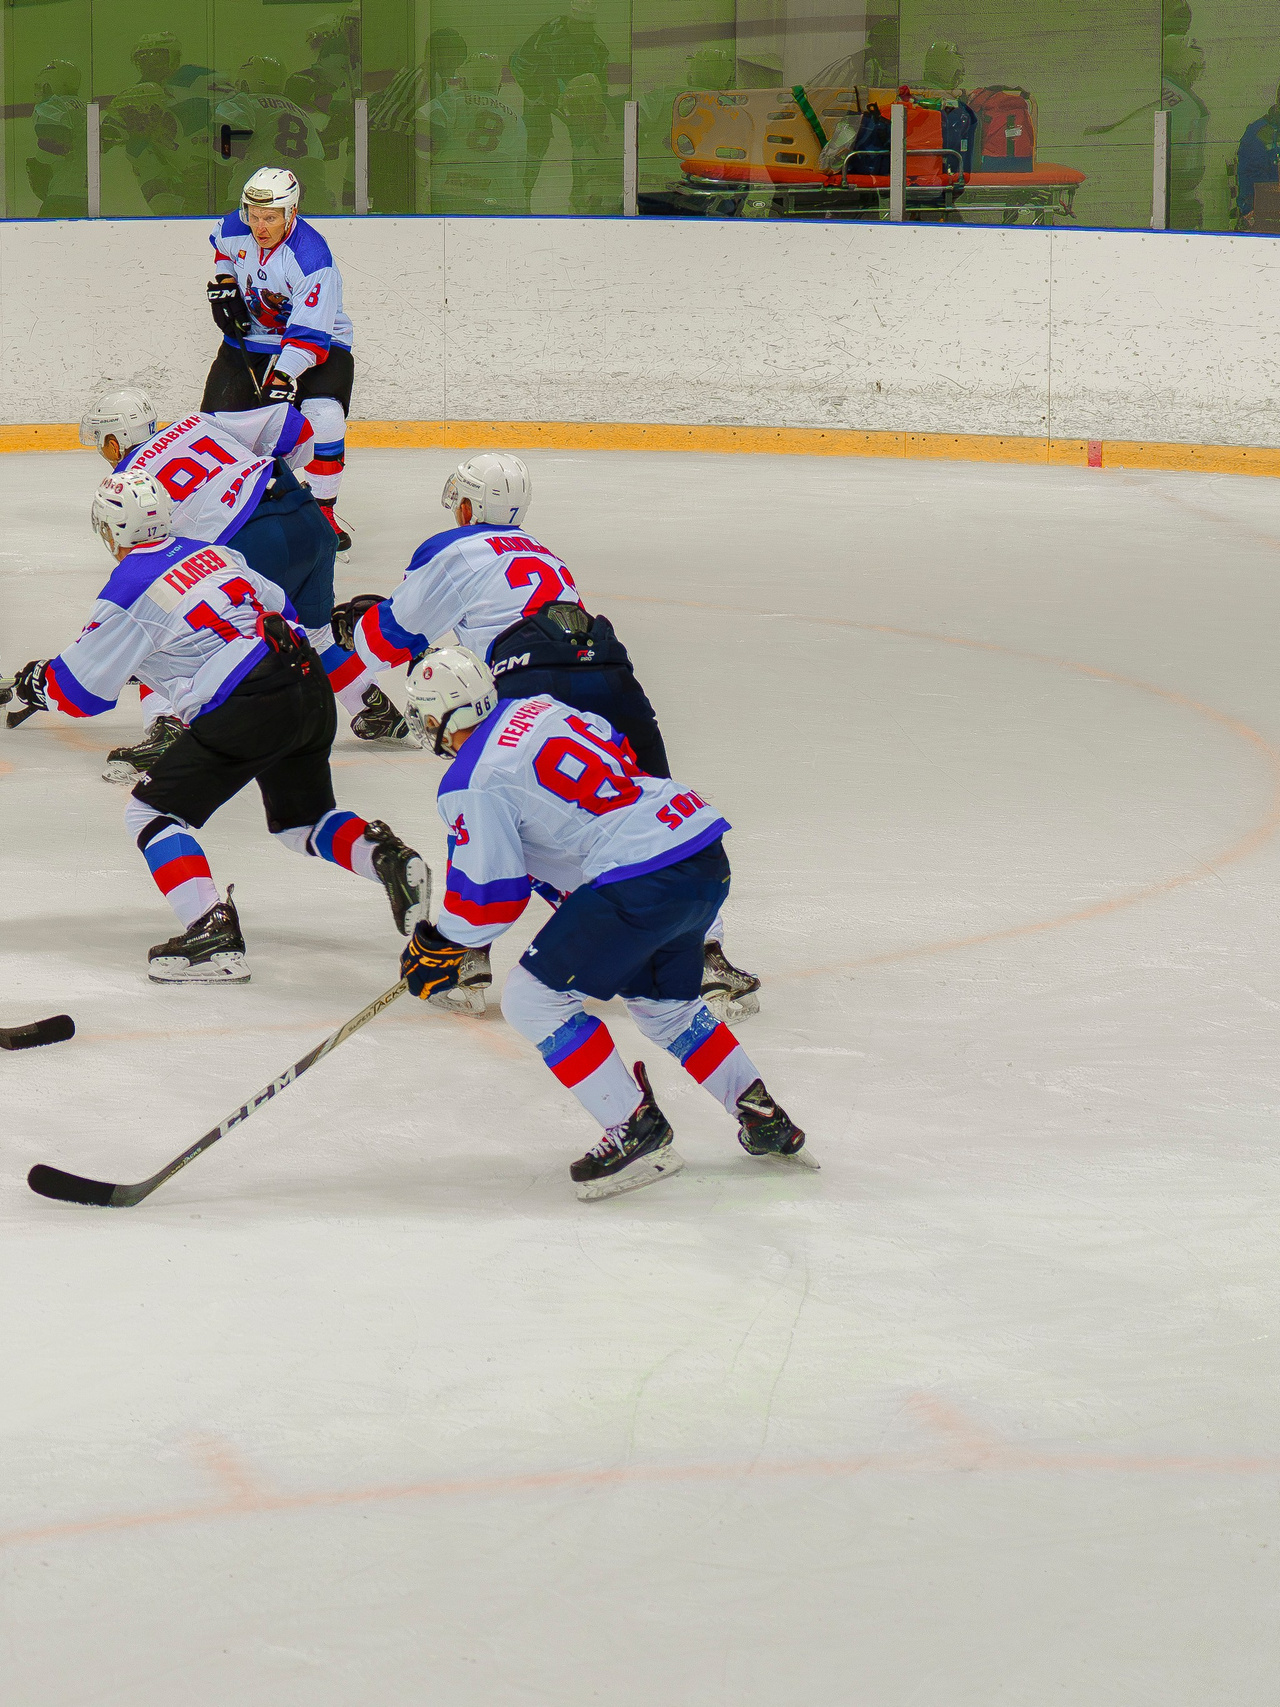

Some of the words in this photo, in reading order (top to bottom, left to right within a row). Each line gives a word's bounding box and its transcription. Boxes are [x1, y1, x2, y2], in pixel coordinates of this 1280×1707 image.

[208, 289, 237, 300] CM
[148, 421, 156, 435] 12
[508, 507, 519, 524] 7
[147, 526, 157, 537] 17
[163, 549, 227, 596] ГАЛЕЕВ
[490, 652, 531, 676] CM
[475, 695, 491, 717] 86
[532, 714, 652, 817] 86
[369, 982, 408, 1016] TACKS
[220, 1065, 297, 1138] CCM
